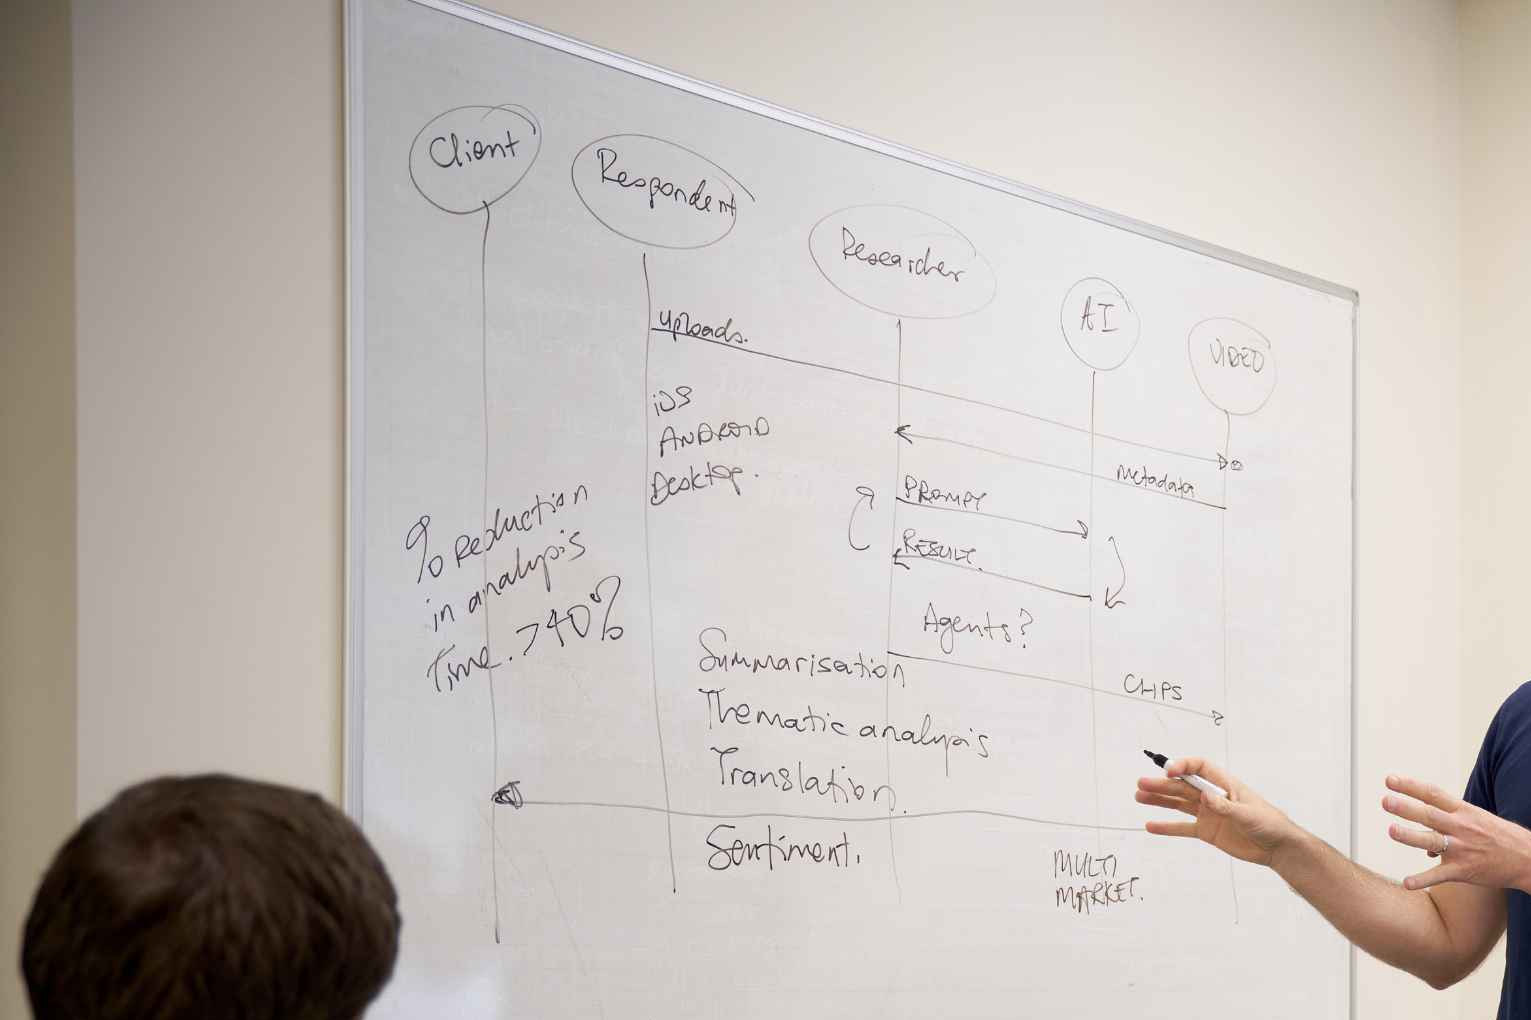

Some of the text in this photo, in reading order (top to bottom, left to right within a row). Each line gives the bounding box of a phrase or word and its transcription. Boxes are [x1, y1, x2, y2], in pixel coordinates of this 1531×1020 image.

[429, 127, 520, 168] Client
[596, 147, 738, 219] Respondent
[841, 225, 966, 283] Researcher
[1079, 295, 1120, 333] AI
[652, 385, 693, 417] iOS
[659, 416, 770, 459] ANDROID
[405, 515, 444, 585] %
[425, 529, 587, 633] in analysis
[923, 601, 1035, 655] Agents?
[698, 626, 907, 689] Summarisation
[697, 687, 990, 778] Thematic analysis
[1053, 848, 1118, 879] MULTI
